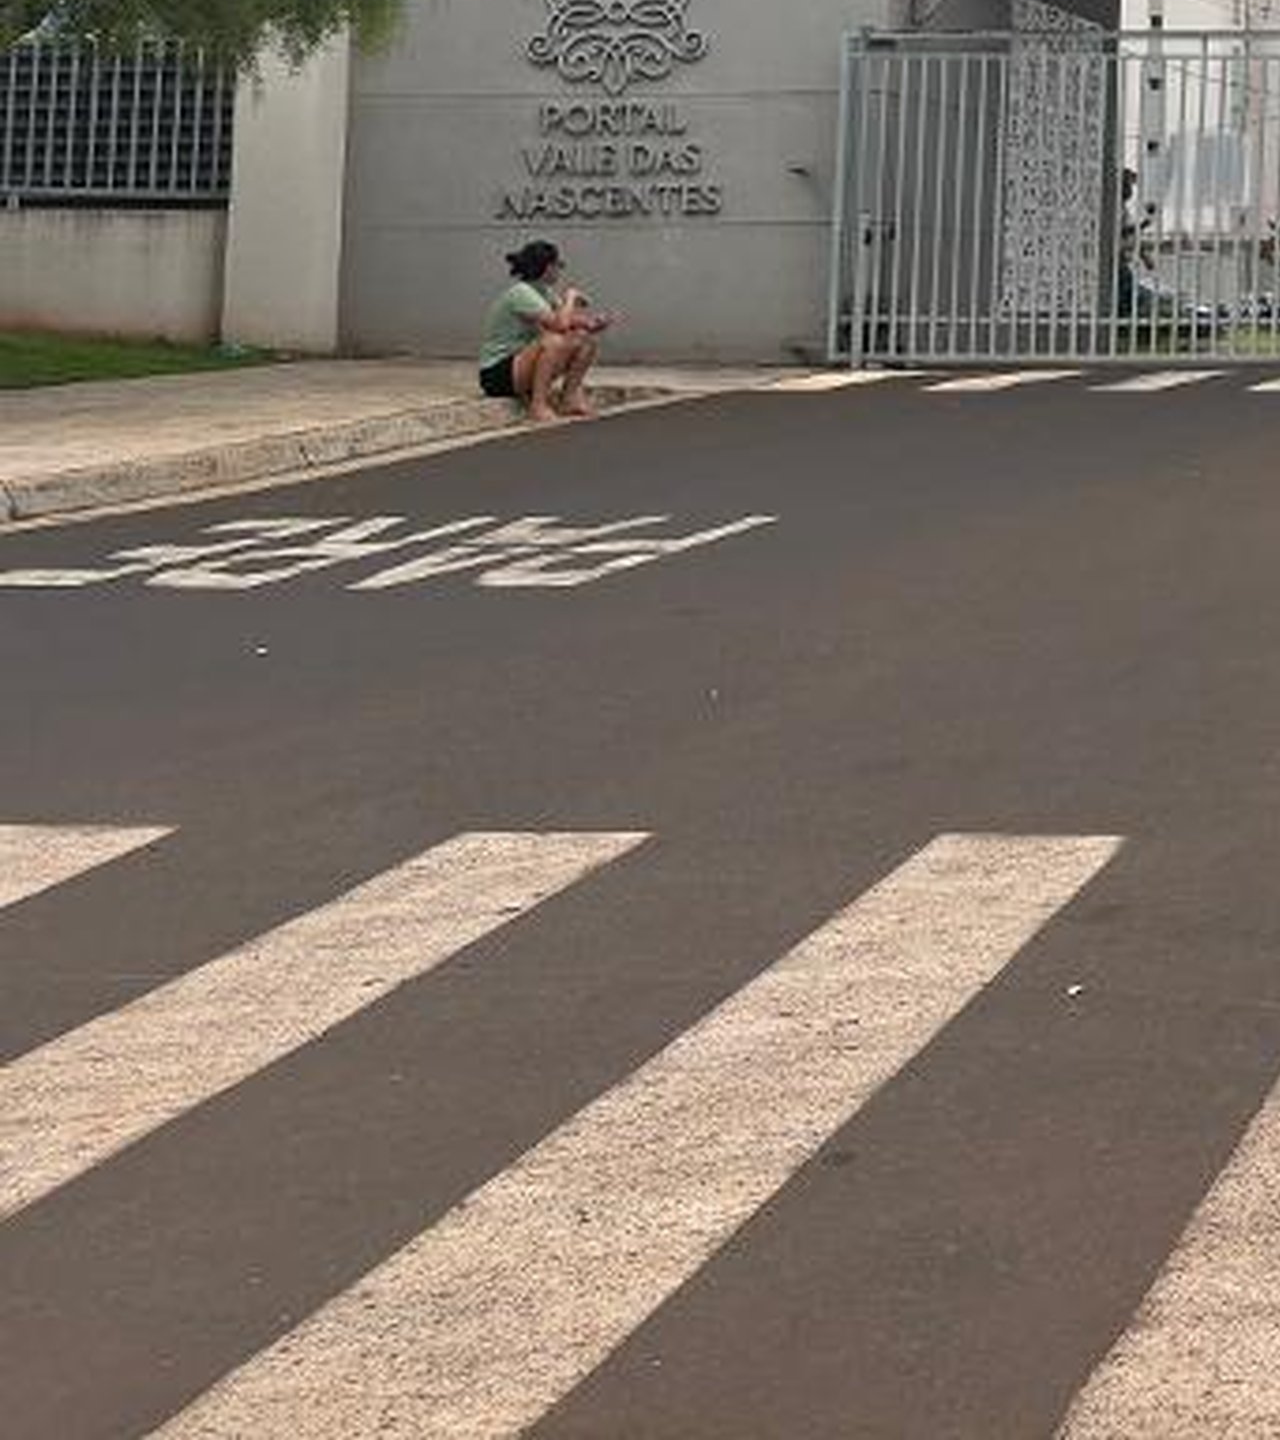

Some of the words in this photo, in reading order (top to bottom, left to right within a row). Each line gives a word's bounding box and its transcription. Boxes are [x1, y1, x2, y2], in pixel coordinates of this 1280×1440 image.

[537, 104, 686, 137] PORTAL
[522, 143, 615, 176] VALE
[626, 142, 702, 176] DAS
[494, 183, 723, 220] NASCENTES
